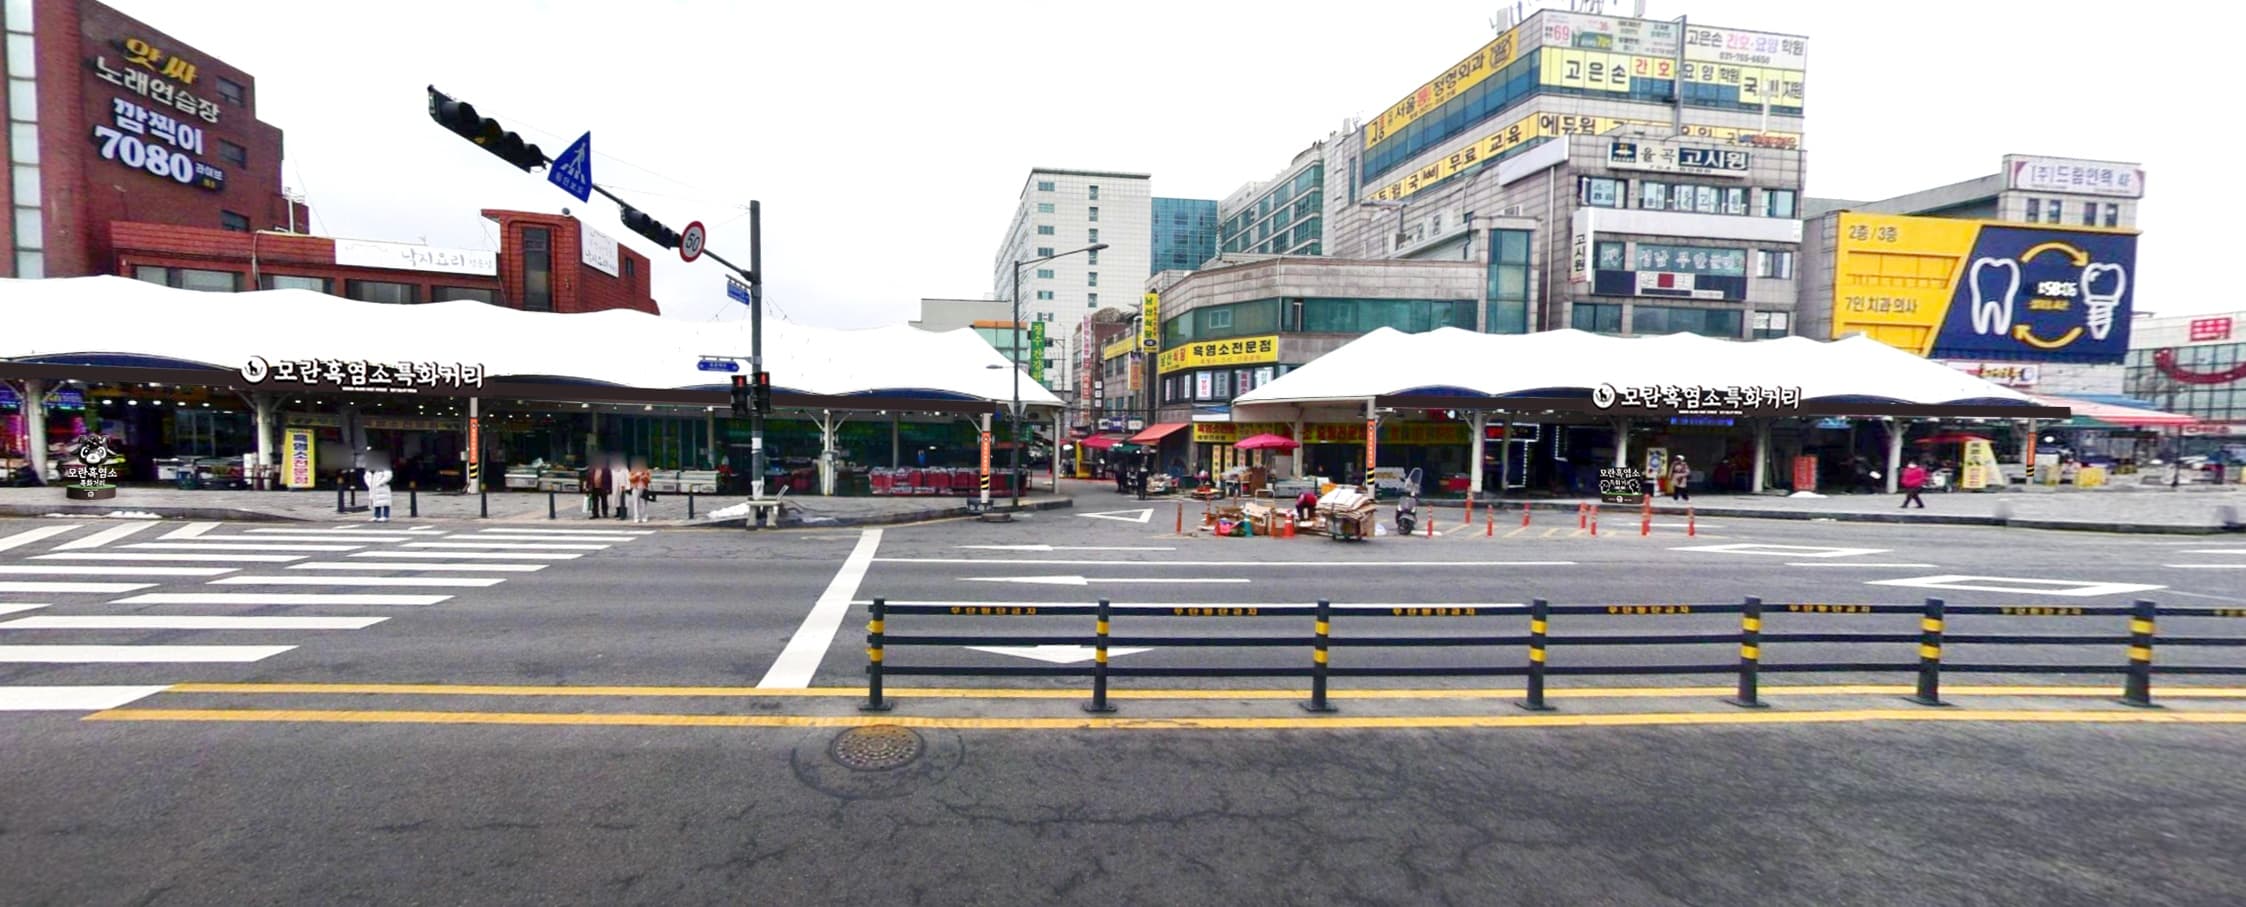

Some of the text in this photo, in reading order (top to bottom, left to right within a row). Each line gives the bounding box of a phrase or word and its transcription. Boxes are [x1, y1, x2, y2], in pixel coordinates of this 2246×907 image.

[1687, 29, 1722, 47] 고은손
[1782, 38, 1804, 56] 학원
[1565, 59, 1627, 84] 고은손
[1635, 58, 1670, 77] 간호
[1719, 67, 1741, 83] 학원
[96, 56, 220, 123] 노래연습장
[113, 97, 203, 155] 깜찍이
[94, 125, 193, 184] 7080
[1450, 148, 1476, 171] 무료
[1489, 125, 1522, 153] 교육
[1680, 148, 1746, 170] 고시원
[685, 233, 700, 250] 50
[1848, 224, 1869, 241] 2층
[1877, 226, 1898, 243] 3층
[402, 248, 465, 268] 낙지요리
[1574, 234, 1586, 273] 고시원
[1845, 296, 1865, 312] 7인
[1193, 339, 1272, 357] 흑염소전문점
[274, 360, 485, 389] 모란흑염소특화거리
[1621, 385, 1800, 409] 모란흑염소특화거리
[67, 466, 118, 479] 모란흑염소
[1600, 468, 1640, 478] 모란흑염소
